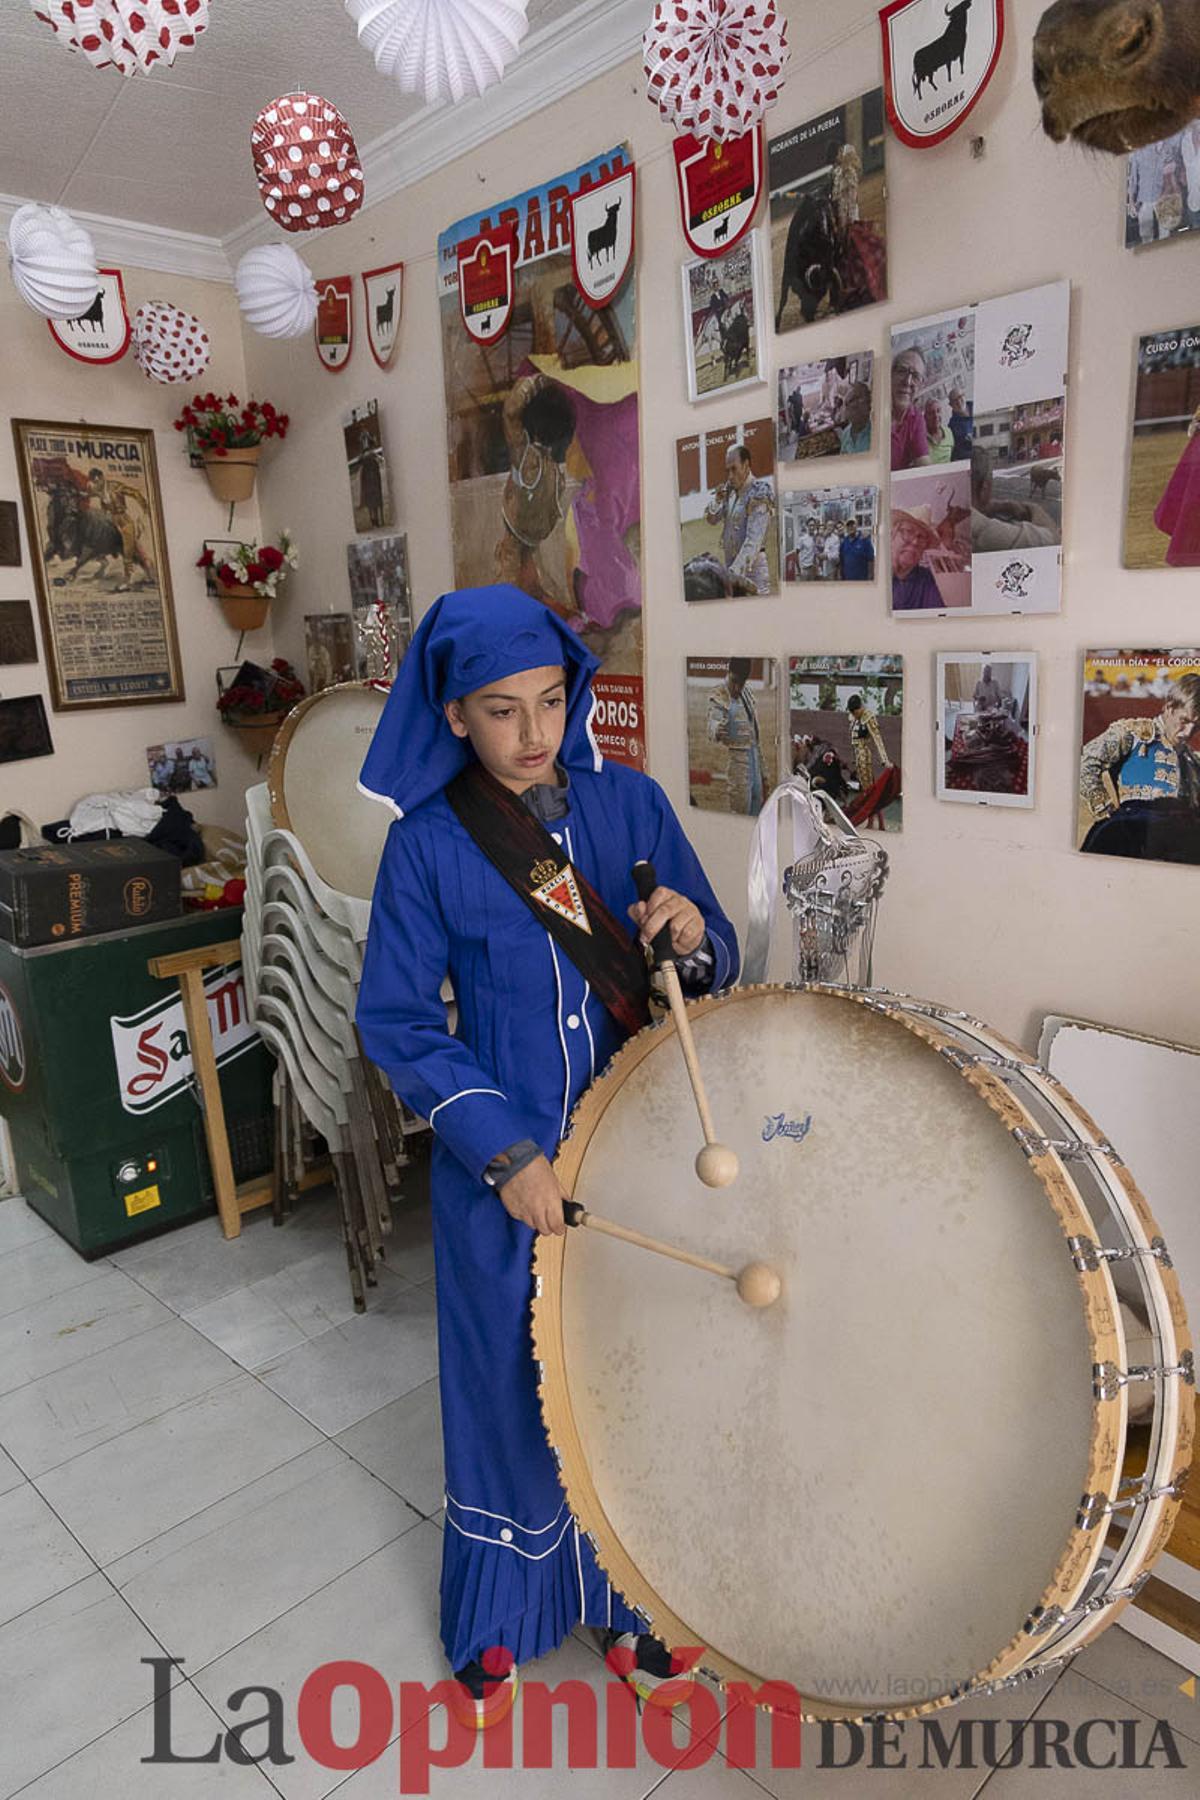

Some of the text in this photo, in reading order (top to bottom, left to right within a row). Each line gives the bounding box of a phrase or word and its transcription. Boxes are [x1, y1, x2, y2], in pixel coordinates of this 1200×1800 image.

[1146, 340, 1178, 354] CURRO
[76, 440, 140, 461] MURCIA
[1092, 658, 1126, 667] MANUEL
[596, 700, 638, 728] OROS
[69, 872, 82, 934] PREMIUM
[127, 1021, 192, 1096] Sa
